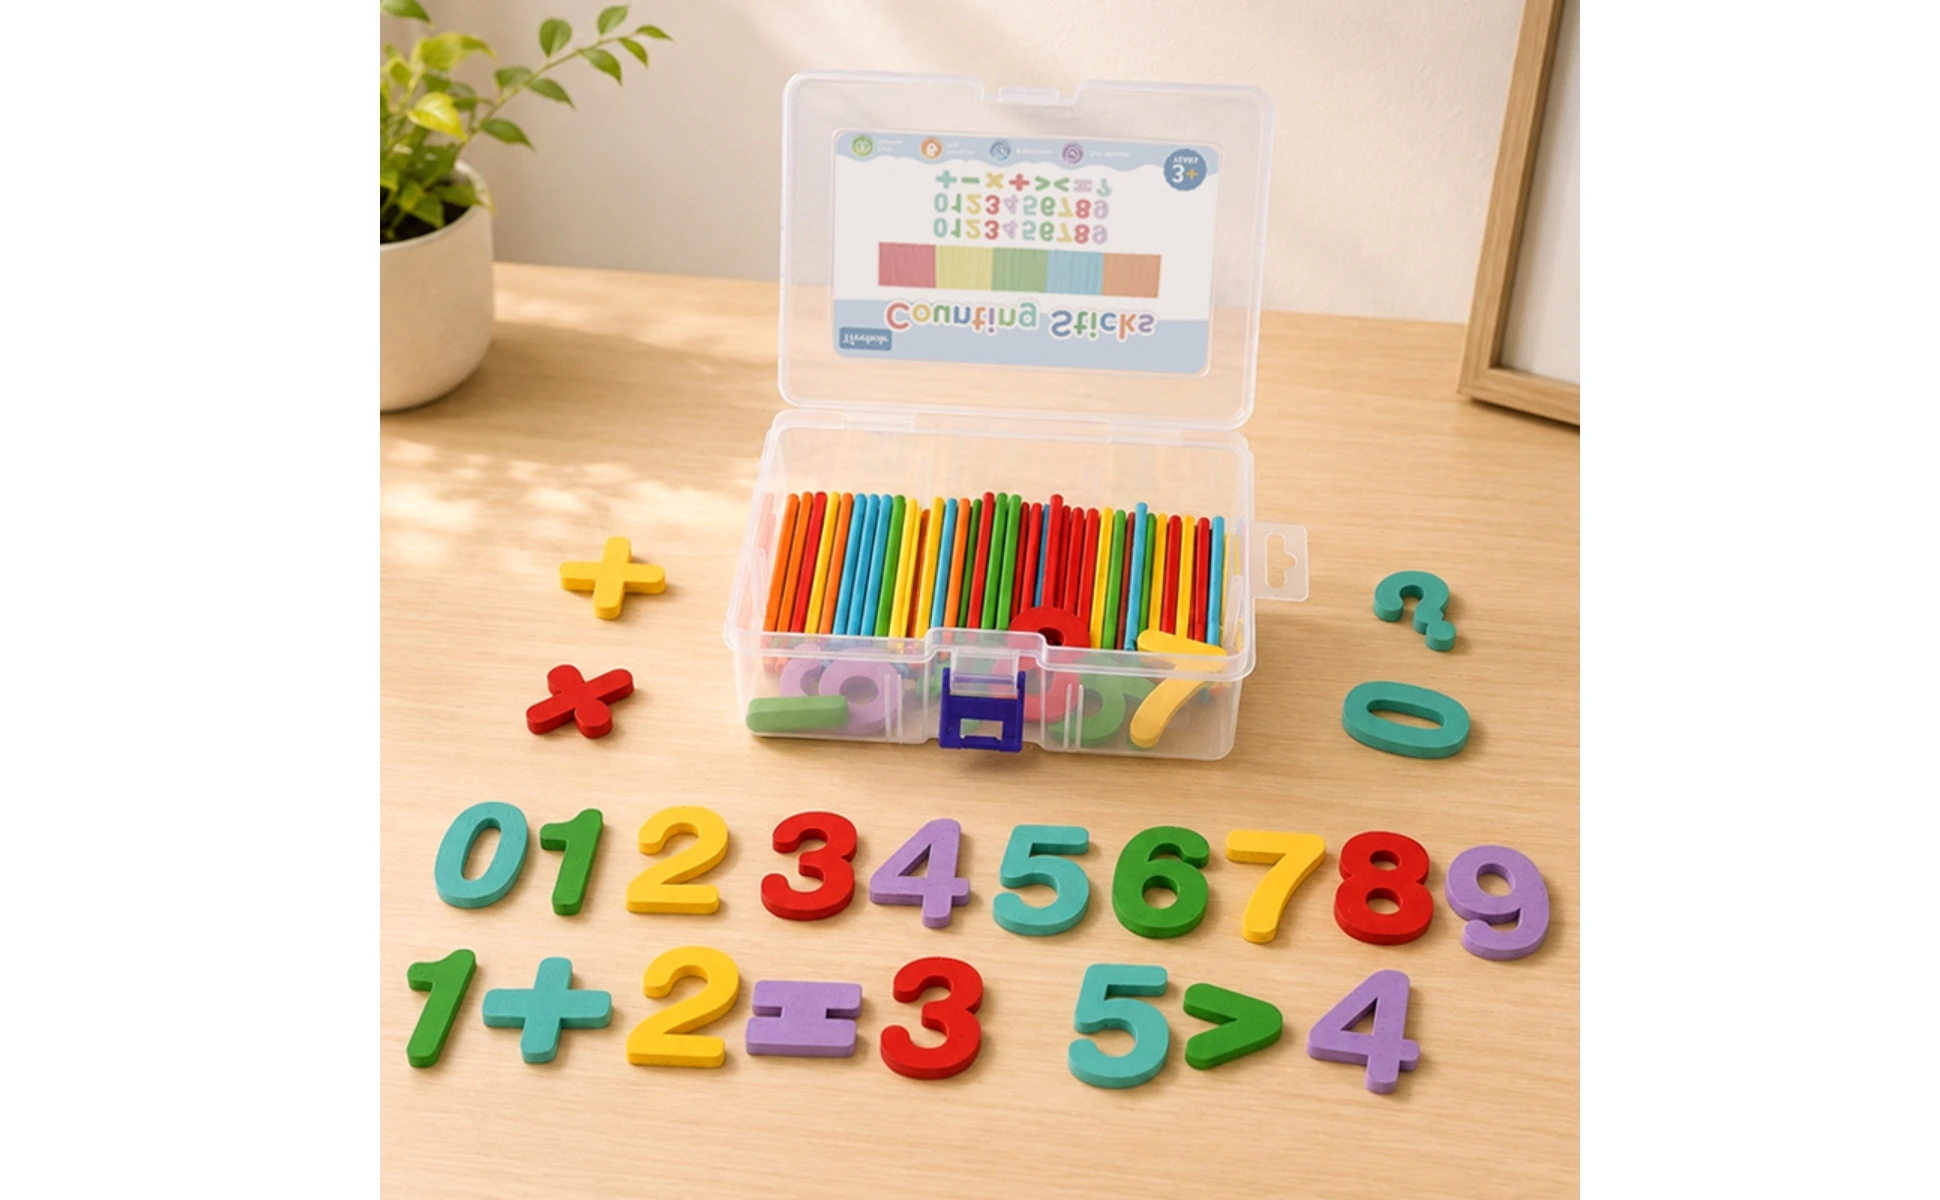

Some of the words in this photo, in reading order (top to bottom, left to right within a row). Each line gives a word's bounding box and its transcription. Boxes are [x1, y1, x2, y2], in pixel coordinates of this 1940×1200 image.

[434, 801, 529, 910] 0
[539, 808, 604, 916] 1
[626, 805, 729, 914] 2
[760, 811, 858, 921] 3
[869, 818, 970, 929] 4
[992, 824, 1090, 937] 5
[1111, 825, 1210, 939] 6
[1225, 829, 1326, 944] 7
[1333, 831, 1434, 946] 8
[1445, 844, 1551, 961] 9
